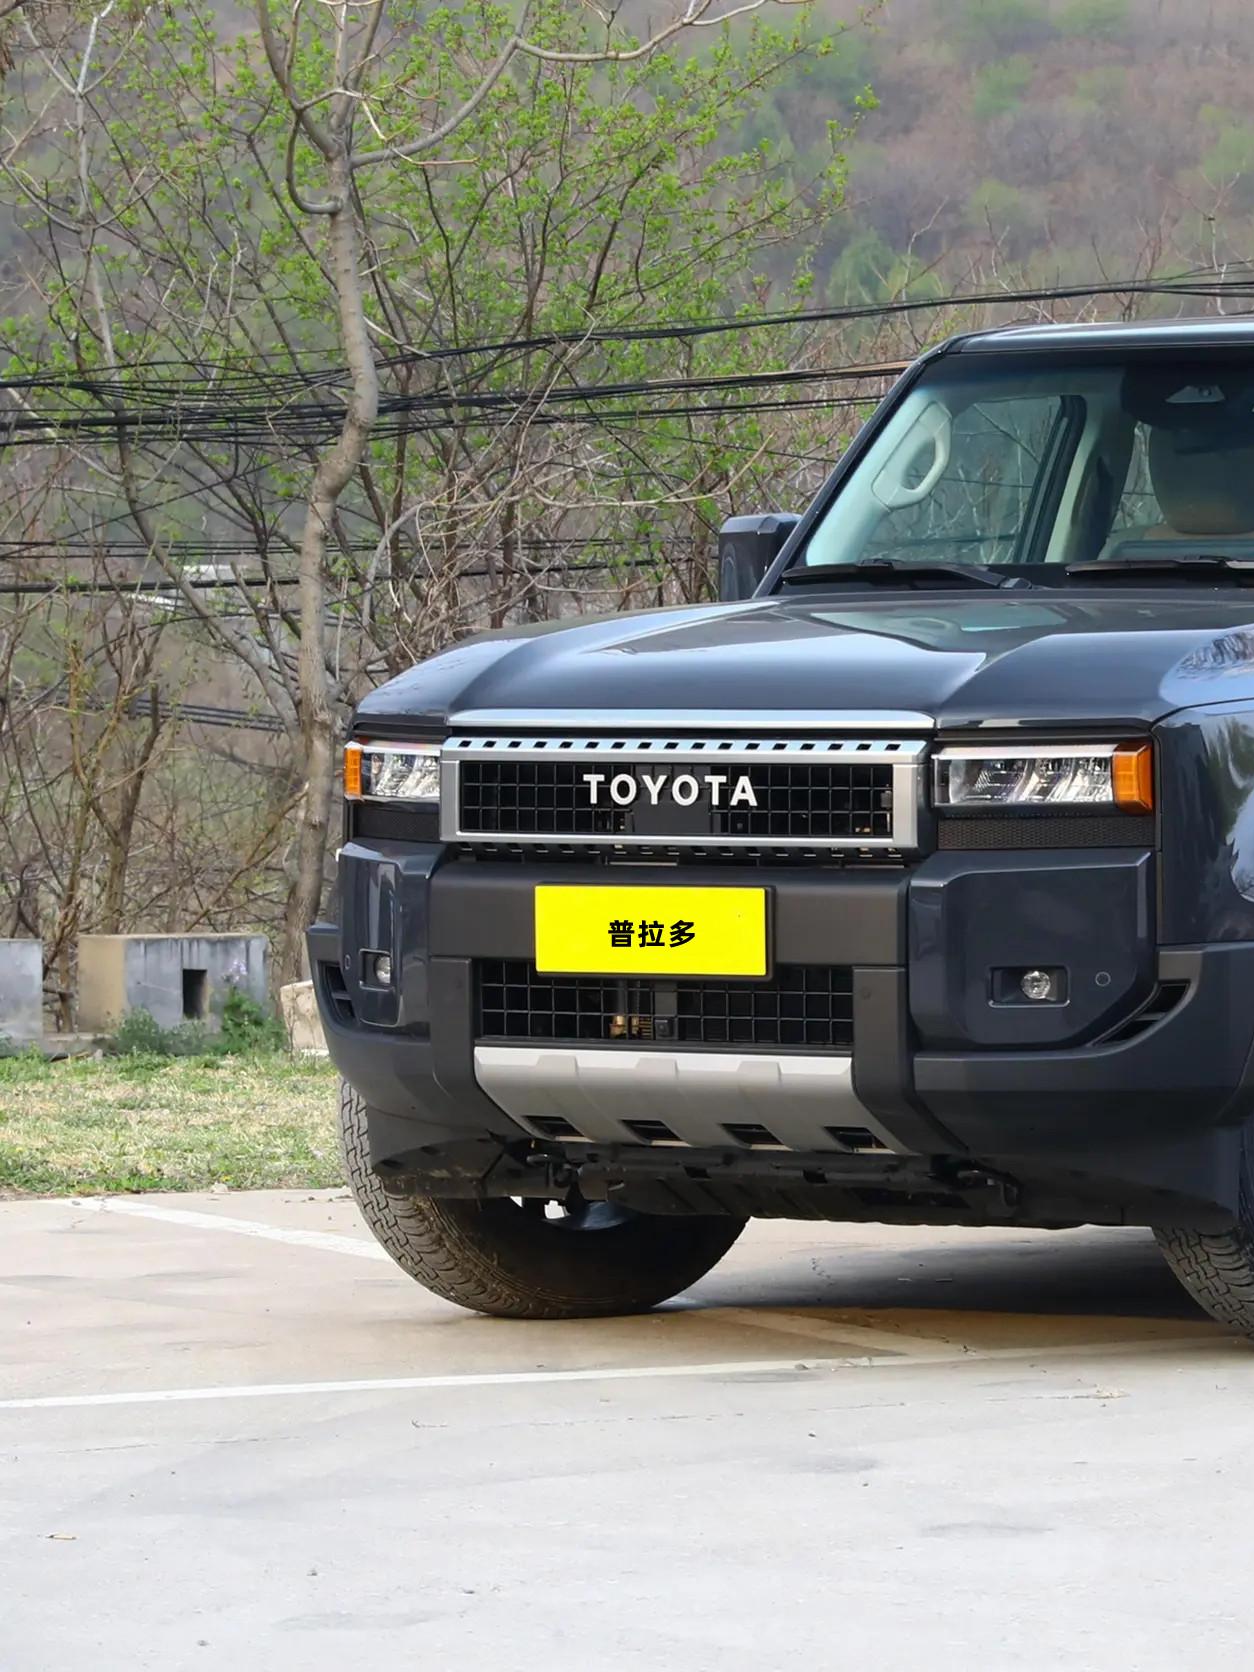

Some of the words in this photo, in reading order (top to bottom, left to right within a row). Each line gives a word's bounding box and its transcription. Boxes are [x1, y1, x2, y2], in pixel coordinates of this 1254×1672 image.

[583, 773, 758, 806] TOYOTA
[607, 919, 696, 948] 普拉多
